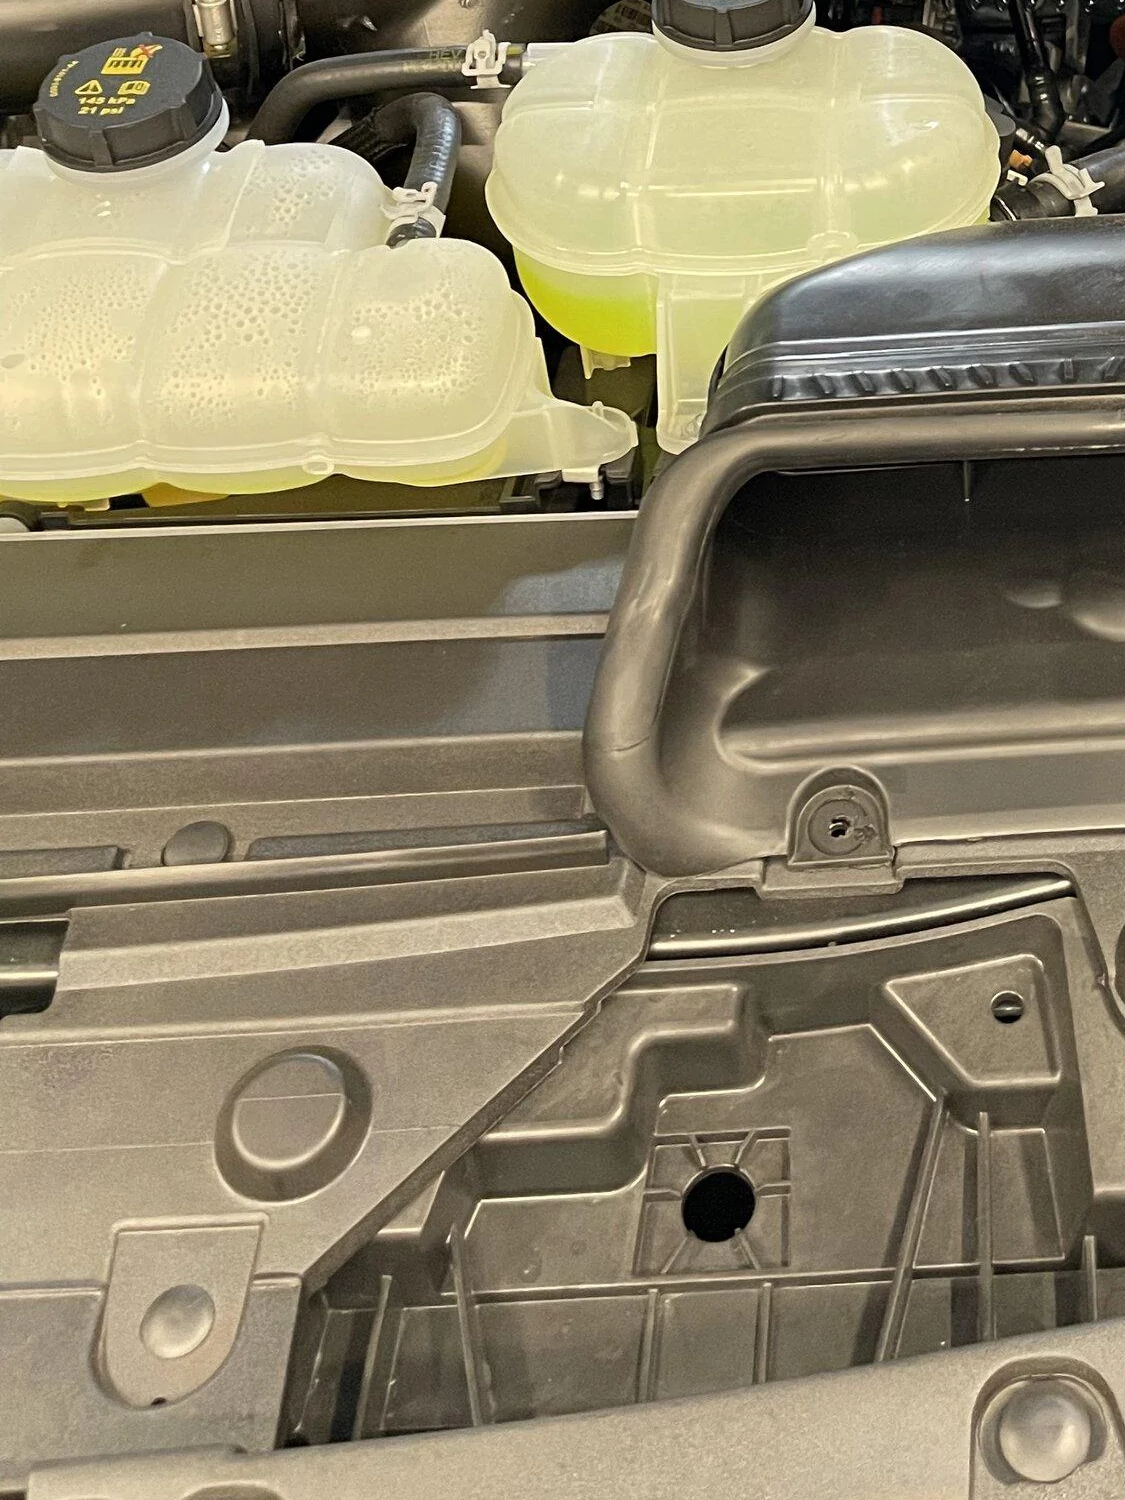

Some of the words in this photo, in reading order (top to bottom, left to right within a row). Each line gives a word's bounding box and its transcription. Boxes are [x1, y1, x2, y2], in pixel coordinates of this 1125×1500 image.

[78, 97, 105, 105] 145
[107, 96, 136, 105] kPa
[77, 106, 97, 115] 21
[99, 106, 125, 115] psi
